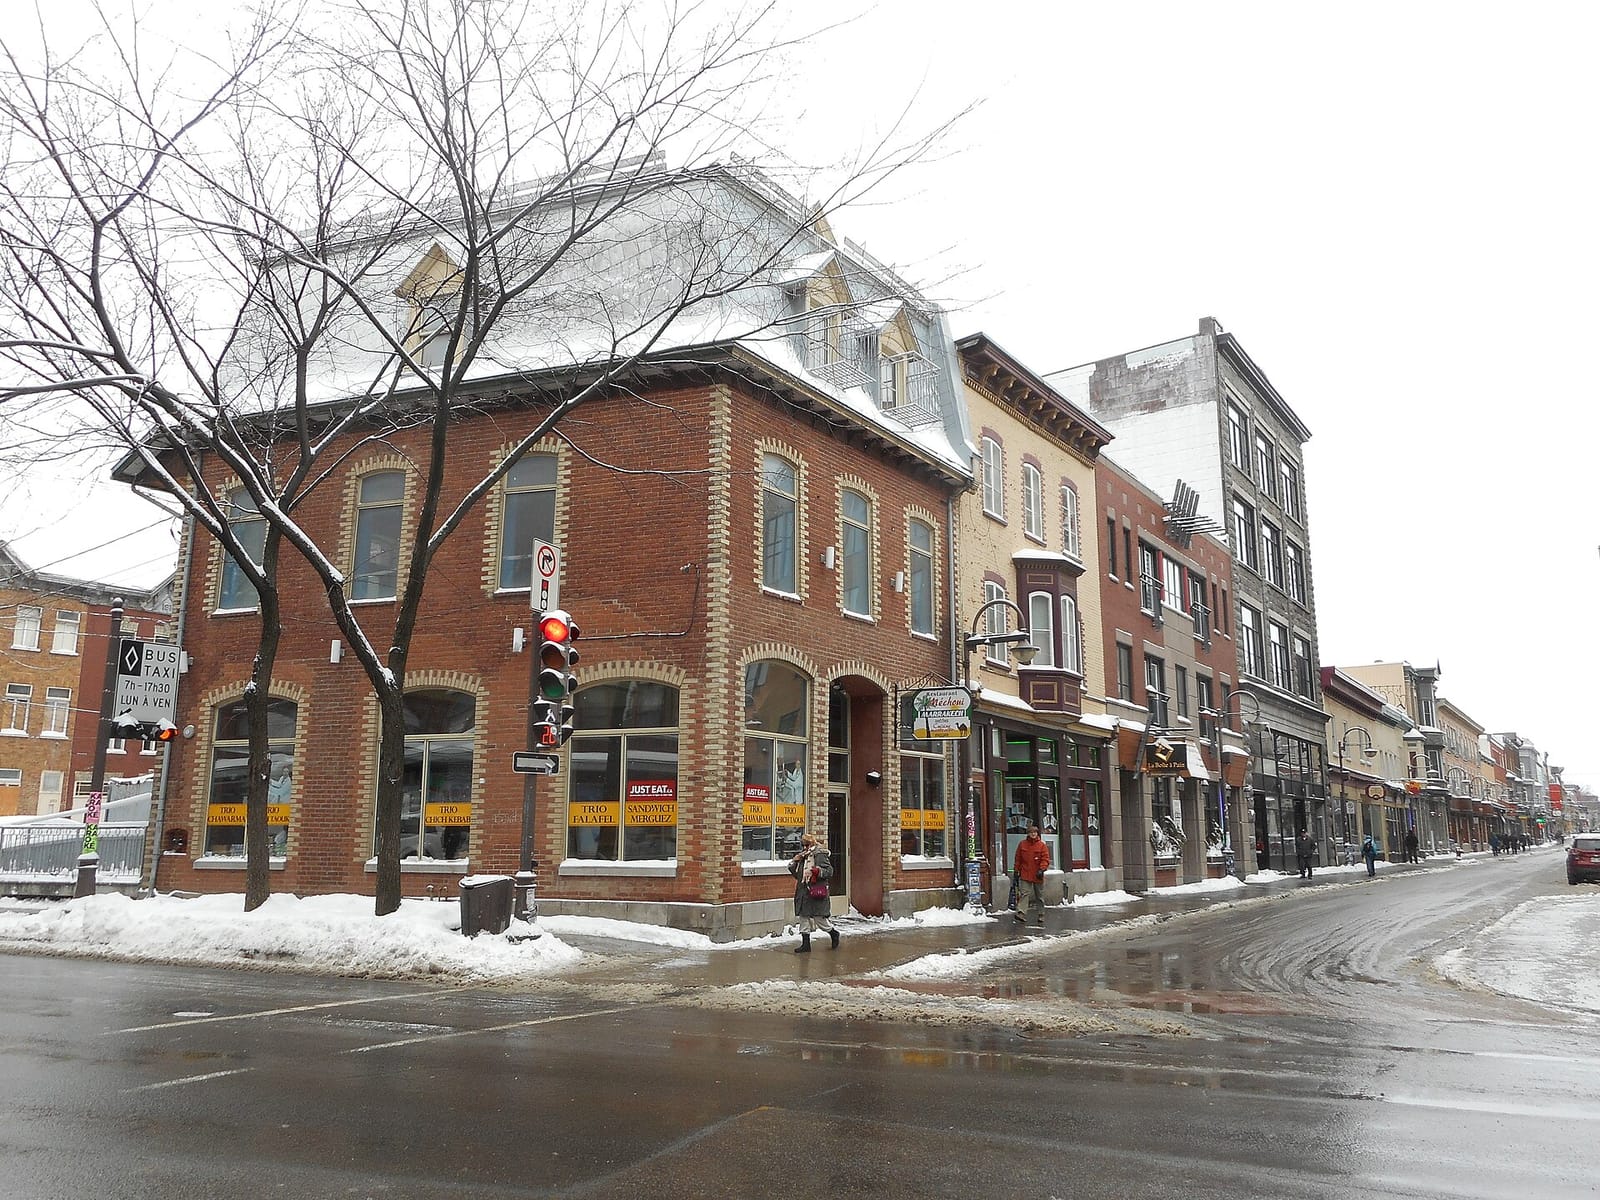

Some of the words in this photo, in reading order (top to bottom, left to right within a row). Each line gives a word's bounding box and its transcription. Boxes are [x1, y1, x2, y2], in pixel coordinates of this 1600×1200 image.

[145, 649, 176, 663] BUS
[144, 665, 175, 679] TAXI
[120, 695, 139, 705] LUN
[142, 695, 149, 706] À
[153, 698, 171, 708] VEN
[921, 710, 964, 718] MARRAKECH
[630, 785, 651, 794] JUST
[746, 788, 758, 796] JUST
[220, 806, 236, 814] TRIO
[267, 806, 280, 814] RIO
[440, 805, 458, 814] TRIO
[582, 804, 608, 813] TRIO
[627, 804, 675, 813] SANDWICH
[749, 804, 763, 814] TRIO
[784, 806, 797, 815] TRIO
[207, 815, 246, 823] CHAWARMA
[425, 815, 447, 823] CHICH
[448, 815, 471, 823] KEBAB
[573, 815, 616, 824] FALAFEL
[630, 814, 672, 823] MERGUEZ
[742, 814, 771, 823] HAWARMA
